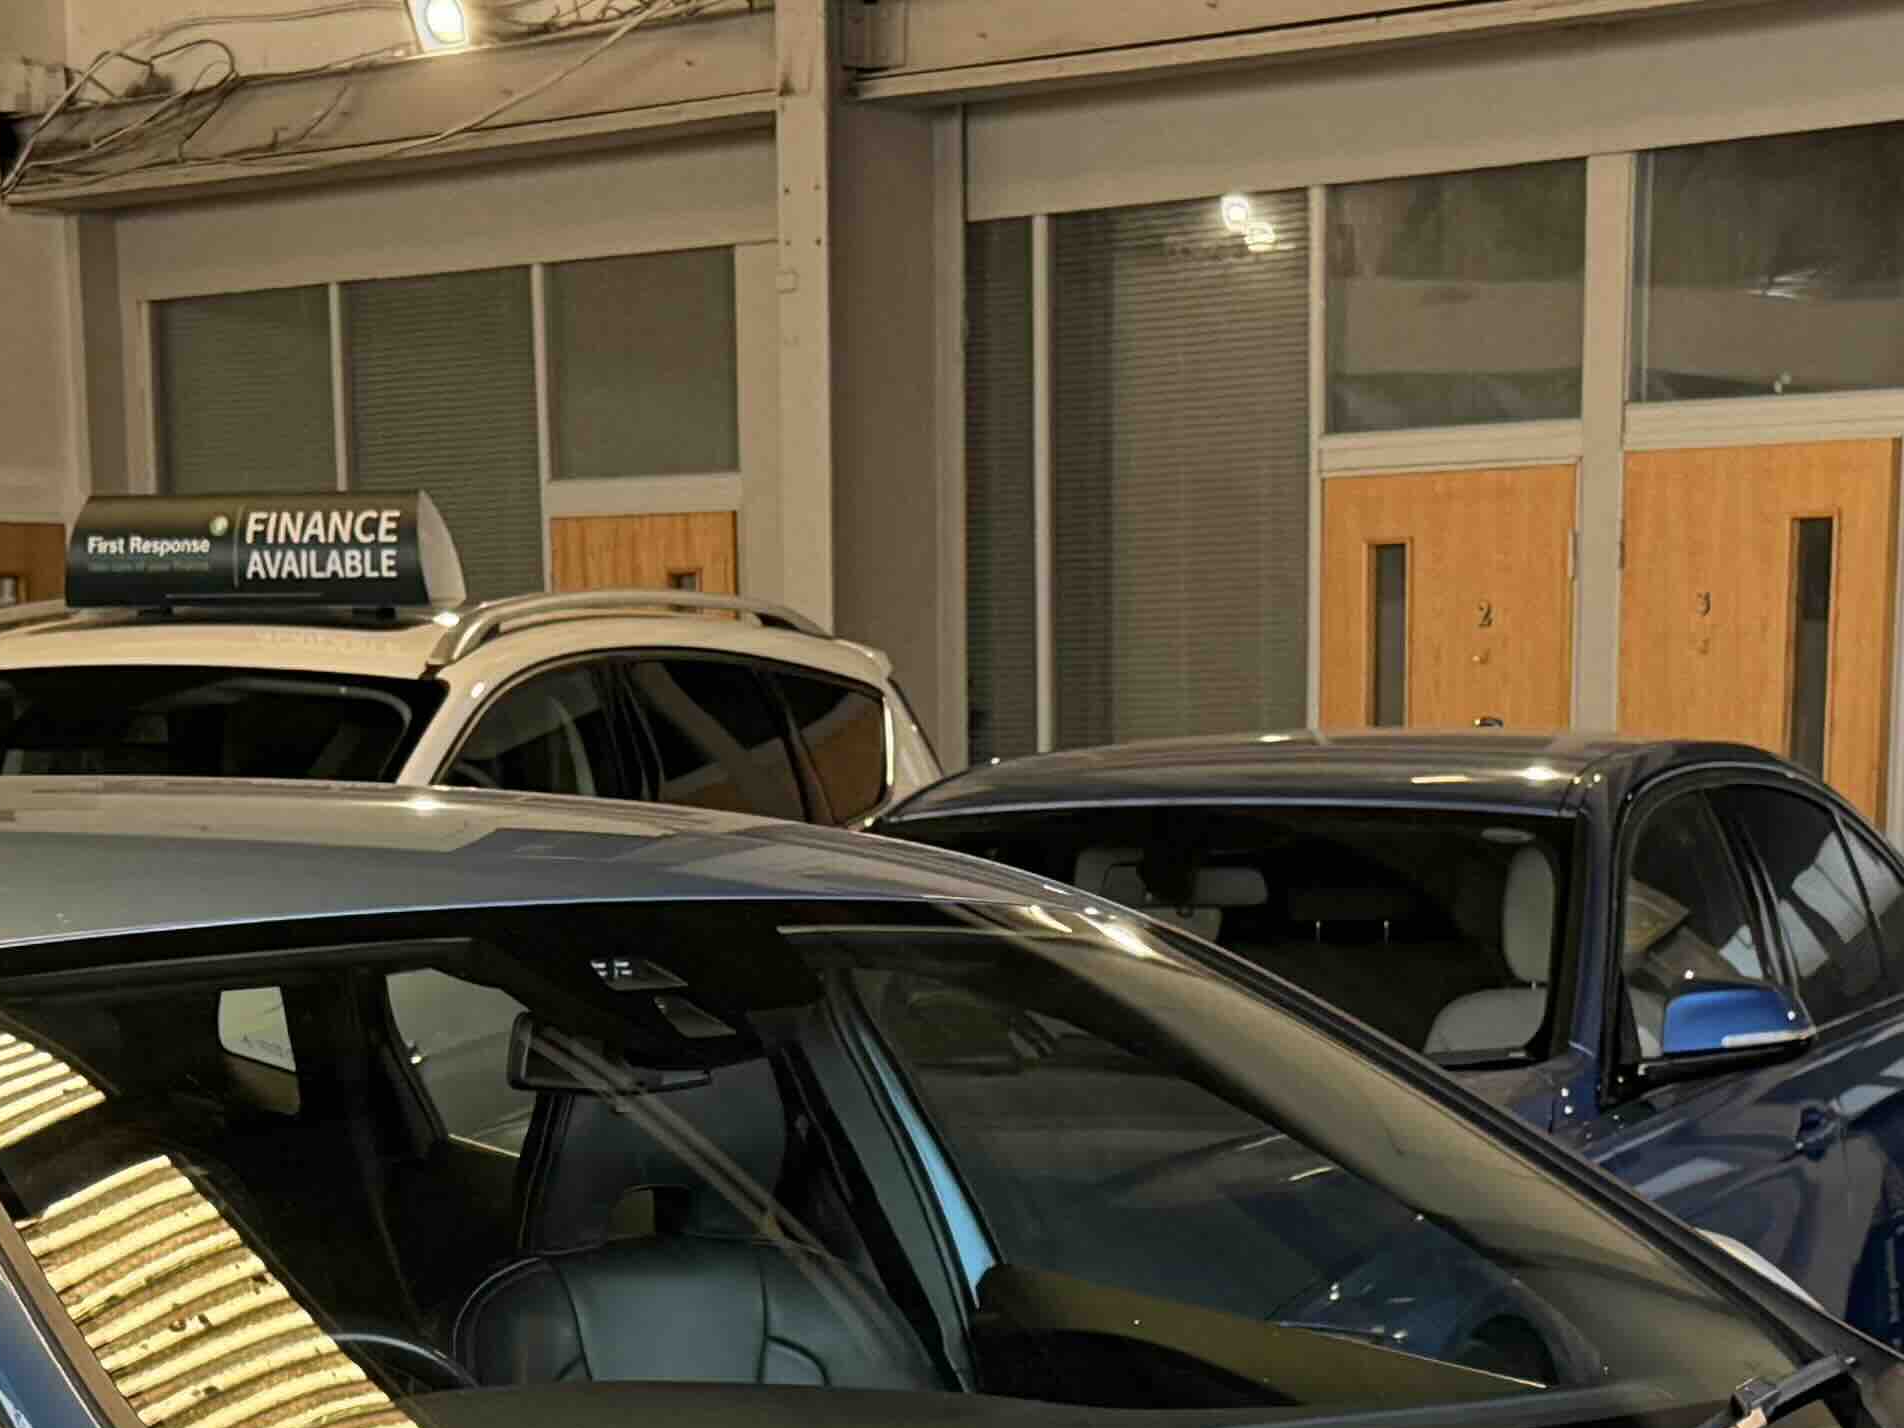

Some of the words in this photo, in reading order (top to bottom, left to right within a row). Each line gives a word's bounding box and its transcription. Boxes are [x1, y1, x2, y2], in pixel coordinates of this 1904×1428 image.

[246, 509, 401, 544] FINANCE
[87, 536, 125, 554] First
[129, 536, 210, 557] Response
[246, 549, 398, 580] AVAILABLE
[1479, 602, 1494, 628] 2
